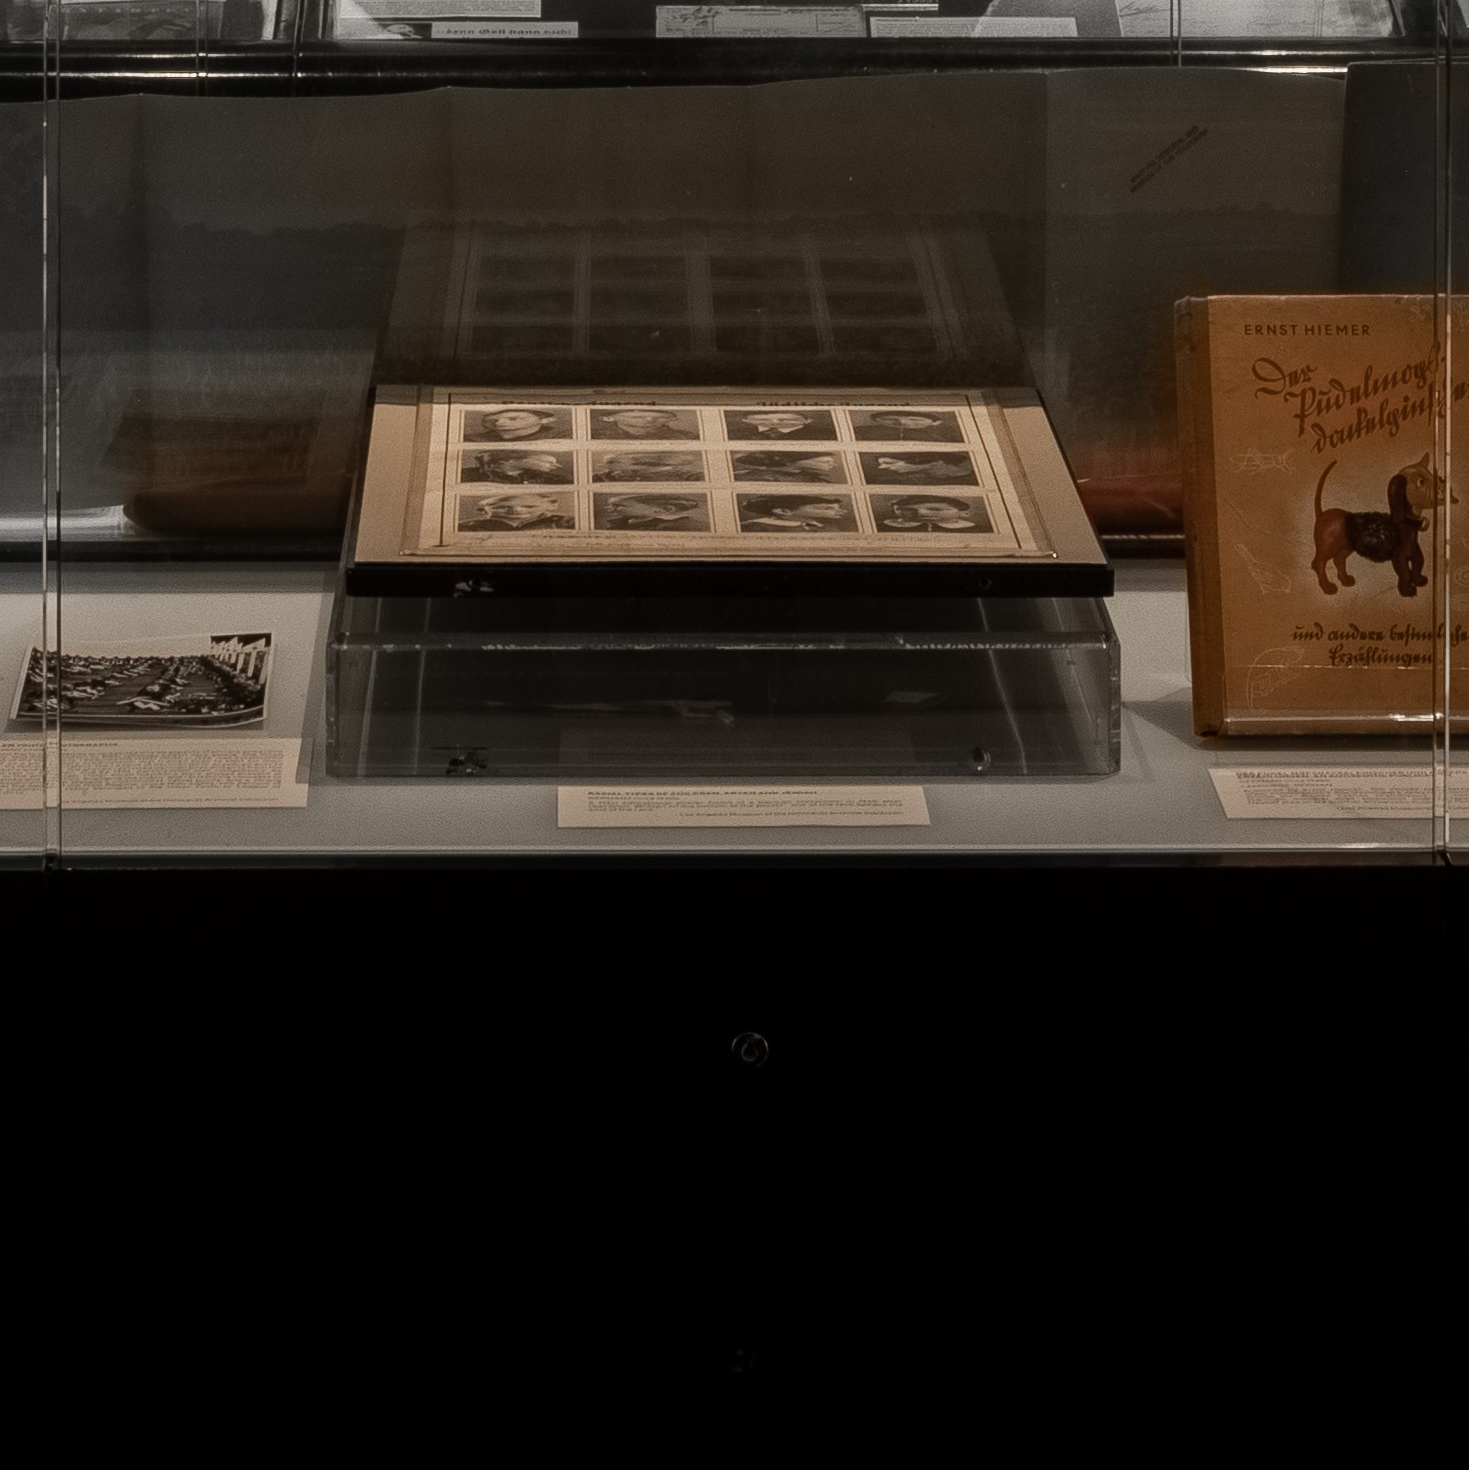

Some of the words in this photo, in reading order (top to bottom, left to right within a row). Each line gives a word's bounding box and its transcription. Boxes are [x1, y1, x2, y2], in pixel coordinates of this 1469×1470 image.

[1244, 325, 1297, 336] ERNST
[1305, 325, 1370, 336] HIEMER
[1252, 357, 1318, 399] Der
